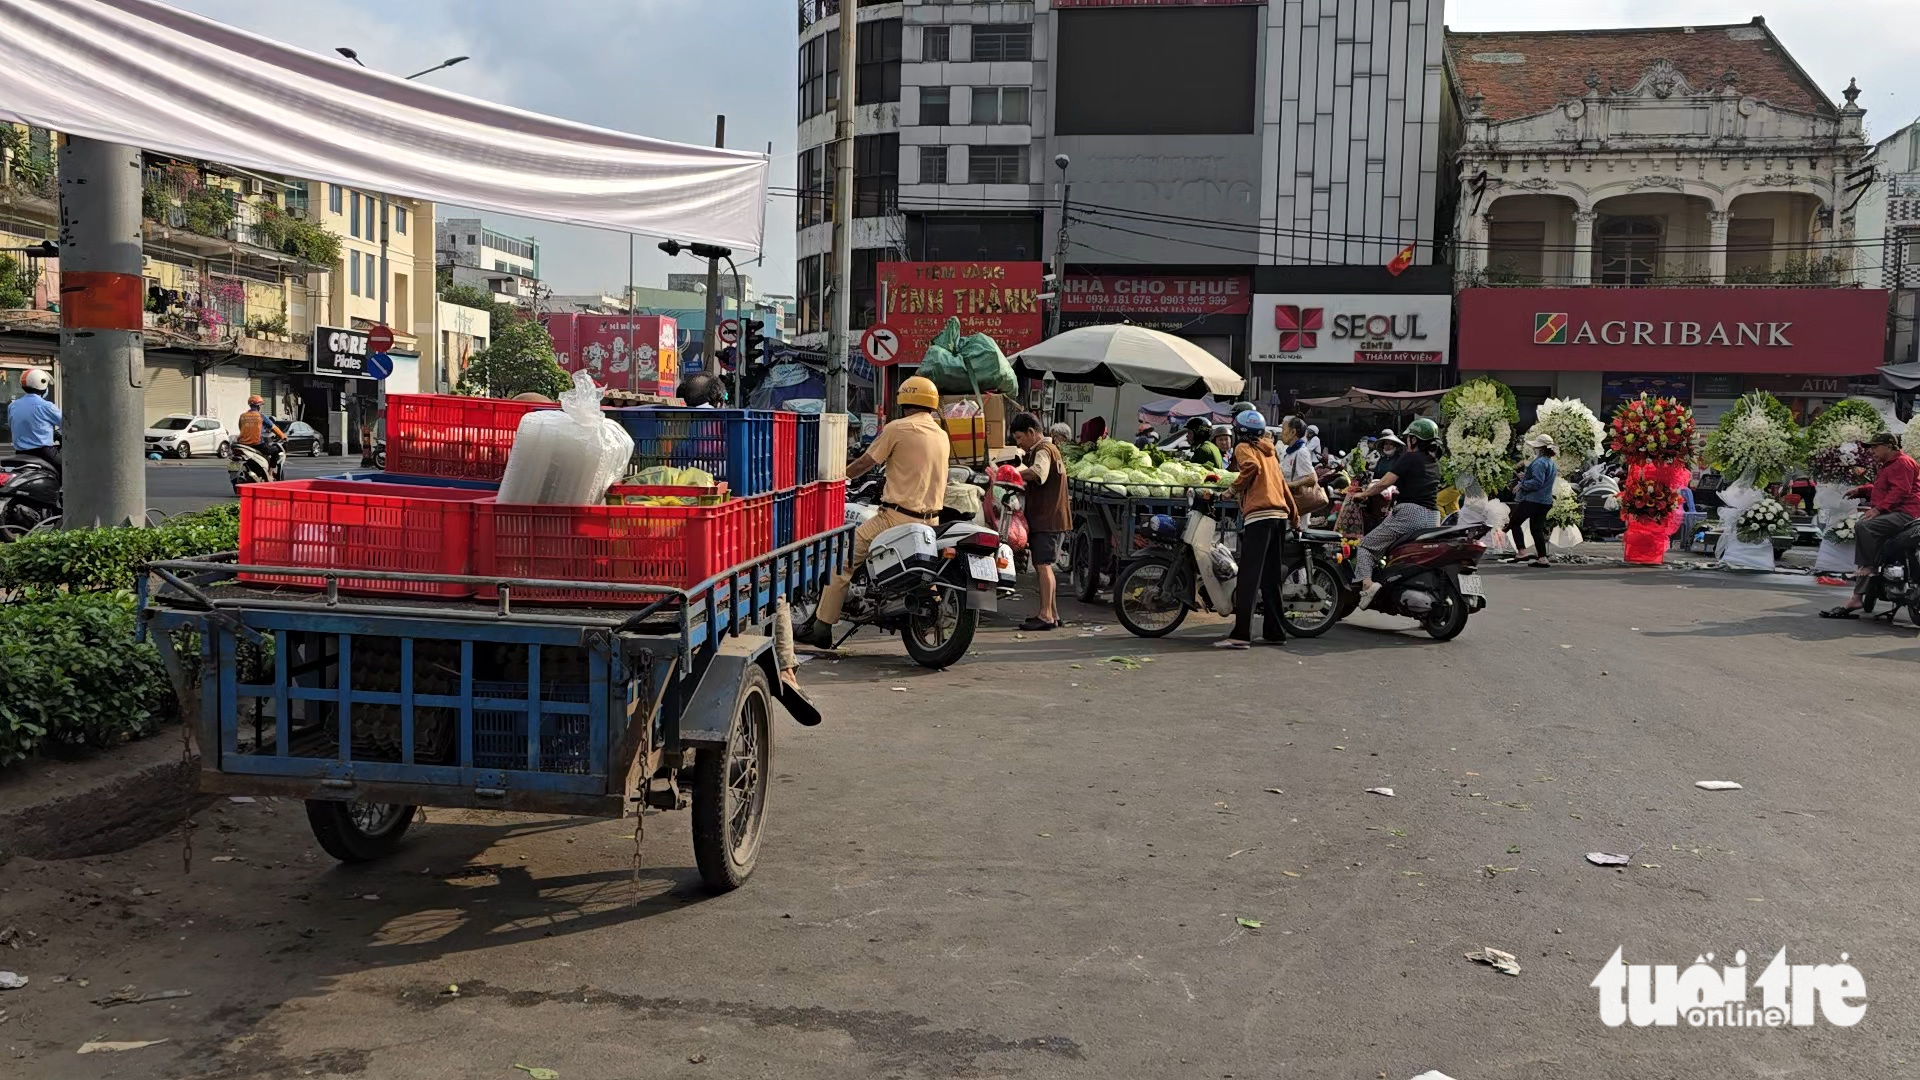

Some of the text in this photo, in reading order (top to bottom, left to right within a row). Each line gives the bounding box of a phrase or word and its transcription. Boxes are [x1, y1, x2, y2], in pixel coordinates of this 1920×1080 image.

[1114, 279, 1166, 295] CHO
[1173, 277, 1240, 295] THUÊ
[1067, 295, 1084, 304] LH:
[1112, 295, 1130, 305] 181
[1331, 314, 1428, 340] SEOUL
[1572, 320, 1794, 347] AGRIBANK
[1360, 342, 1393, 350] CENTER
[333, 353, 362, 370] Pilates
[1801, 379, 1838, 391] ATM
